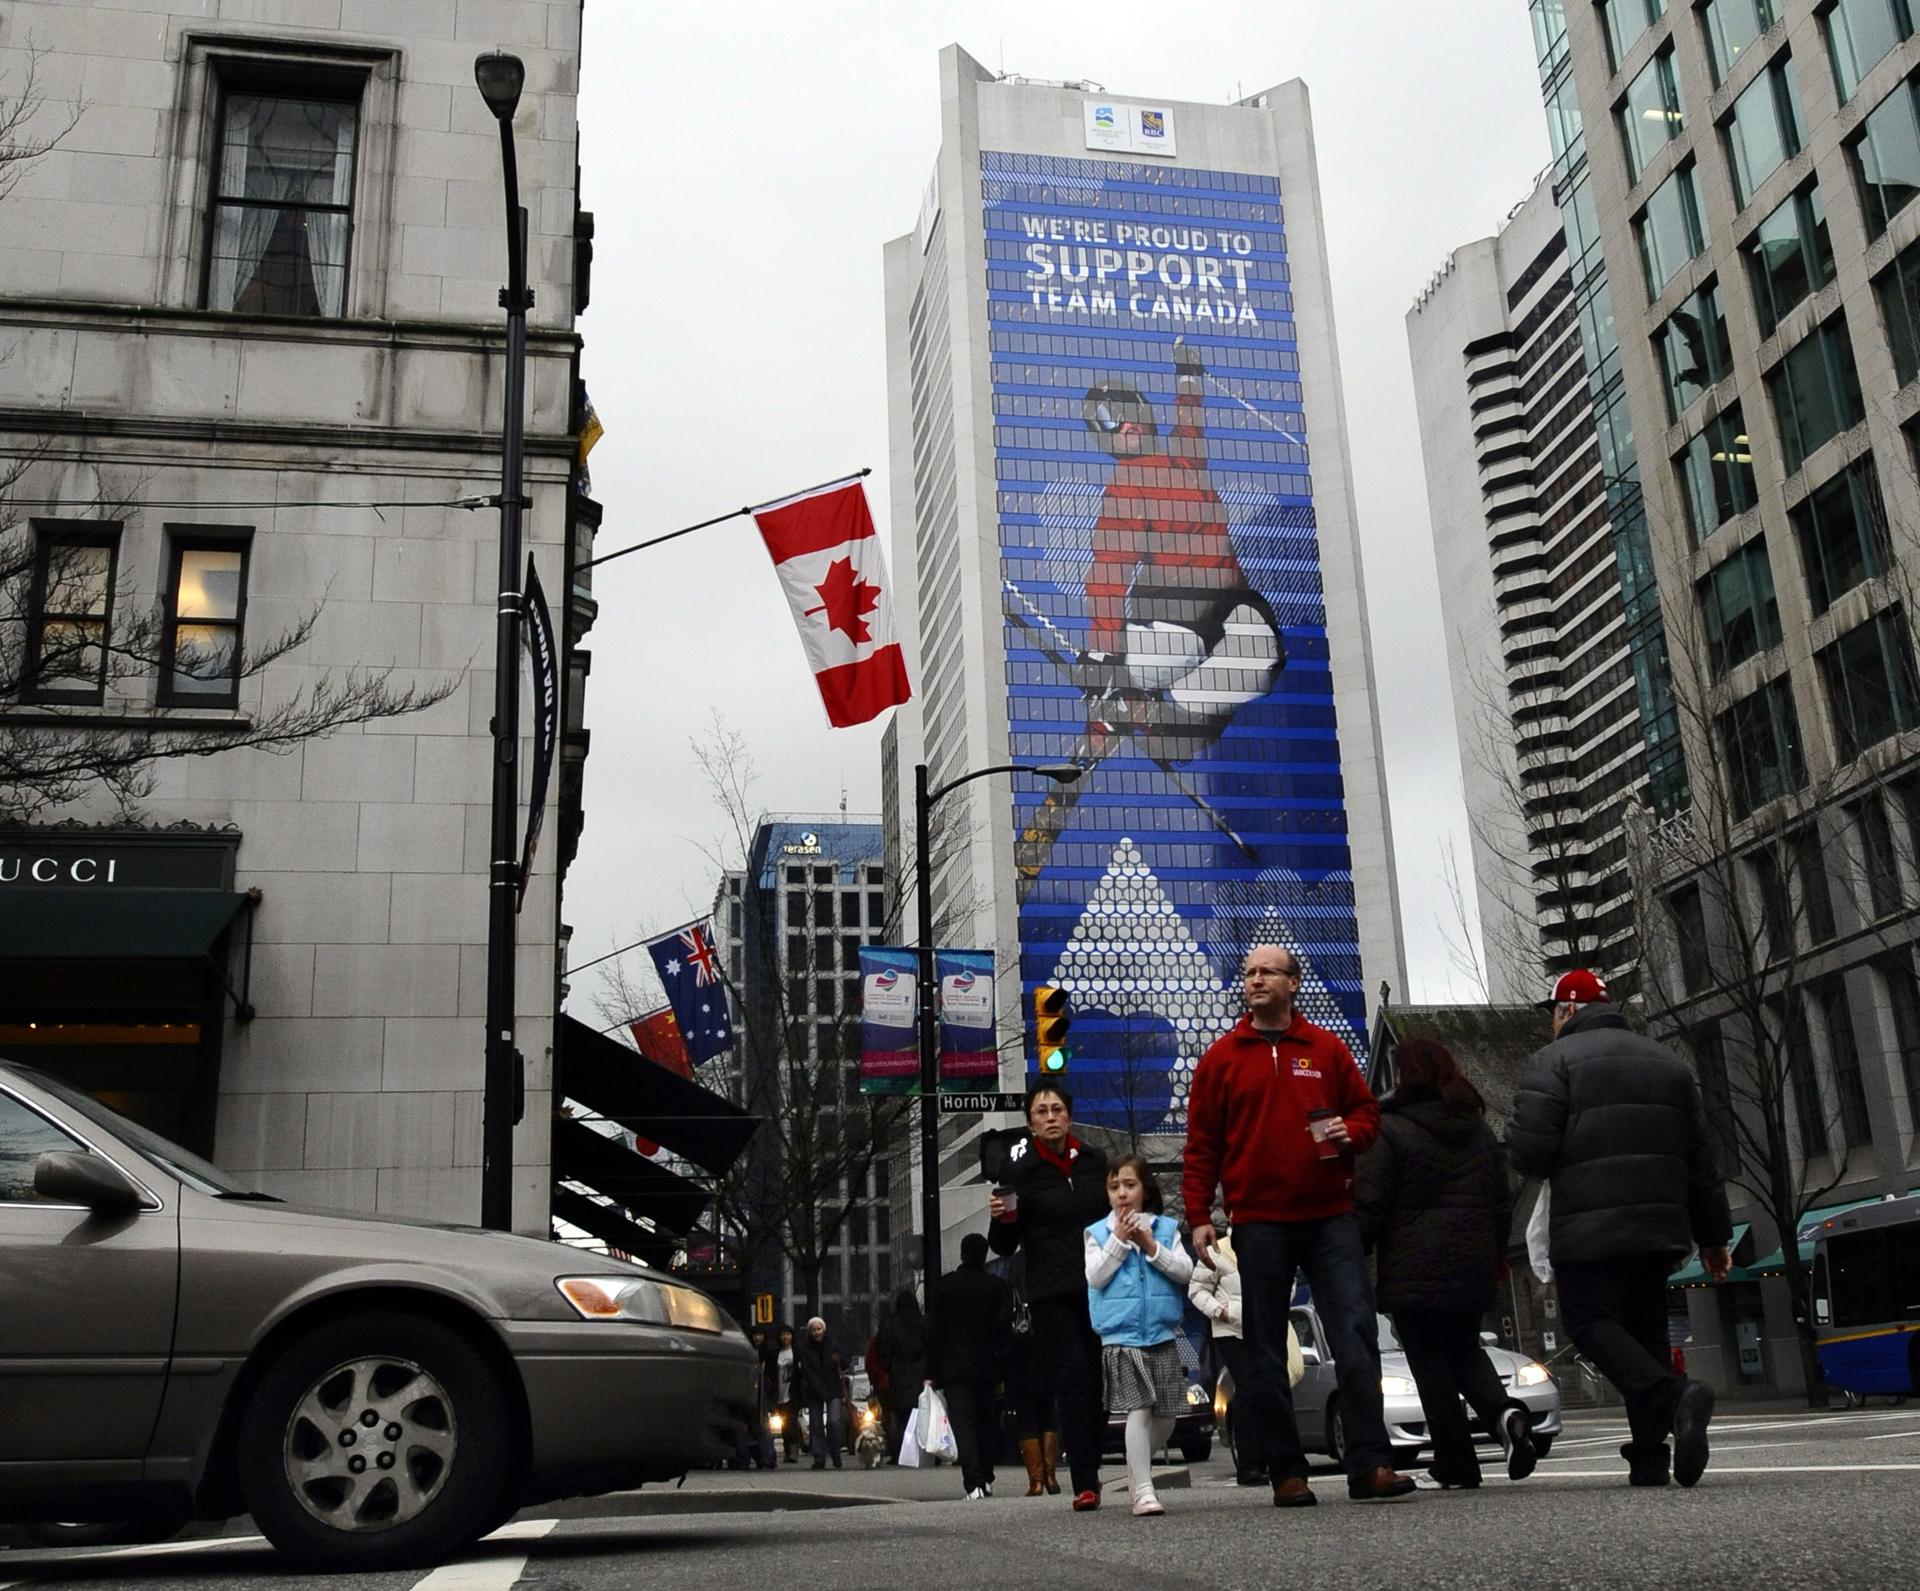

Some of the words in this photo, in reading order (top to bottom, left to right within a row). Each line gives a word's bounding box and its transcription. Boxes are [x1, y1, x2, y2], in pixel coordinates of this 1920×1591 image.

[1143, 127, 1163, 137] RBC
[1023, 217, 1108, 243] WE'RE
[1117, 225, 1208, 251] PROUD
[1217, 233, 1251, 254] TO
[1026, 244, 1253, 295] SUPPORT
[1027, 285, 1117, 316] TEAM
[1129, 293, 1259, 326] CANADA
[944, 1094, 997, 1111] Hornby
